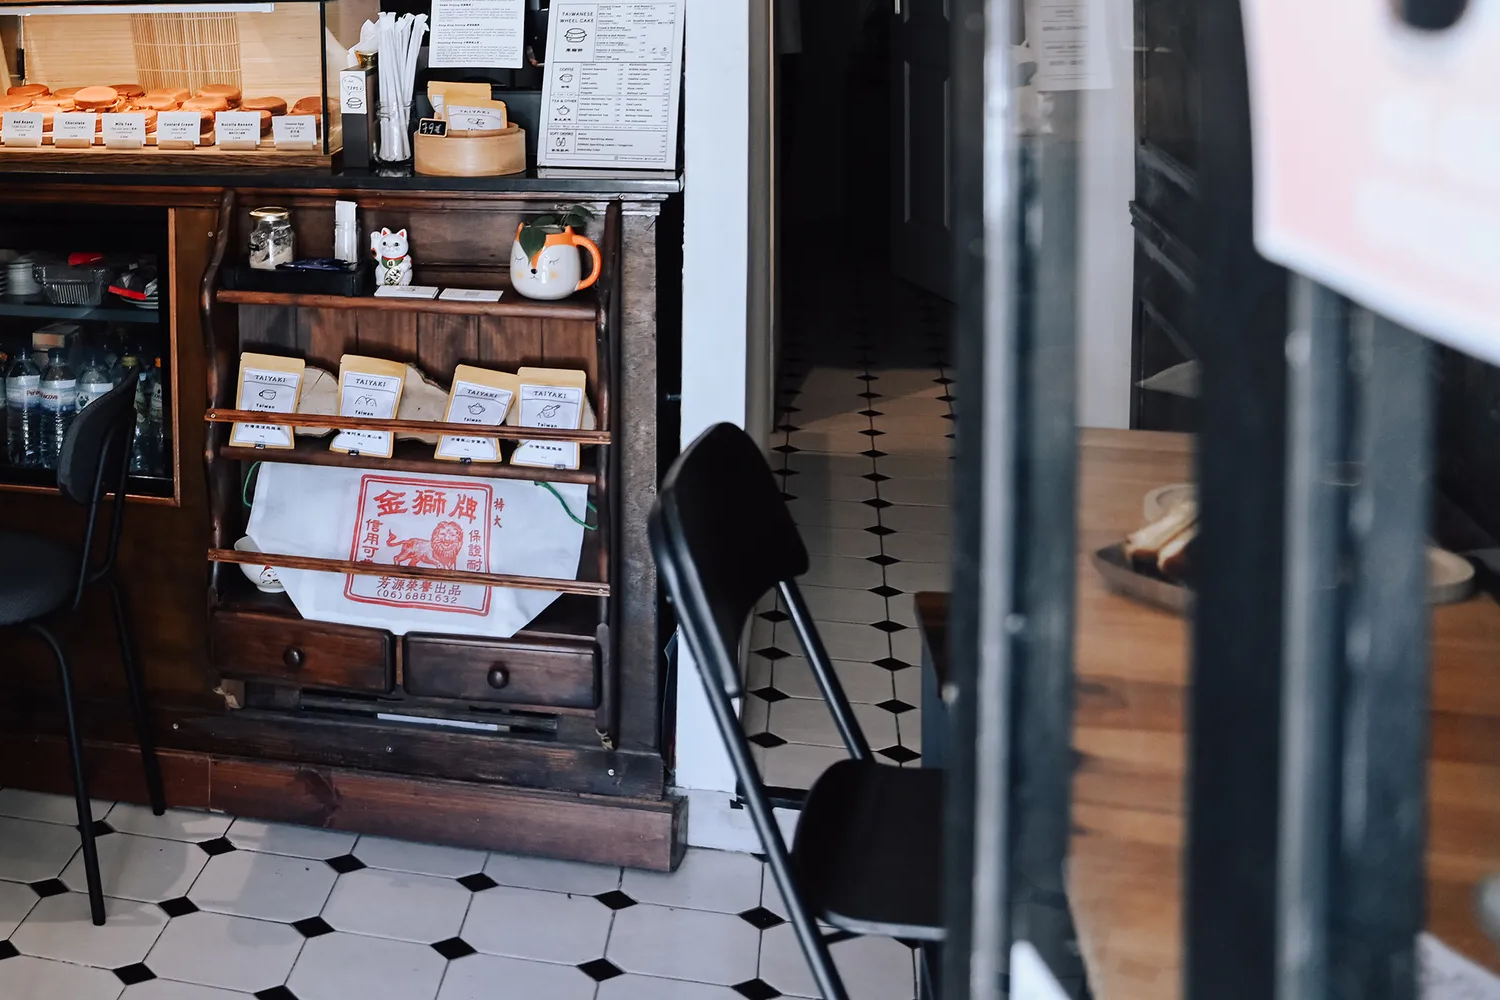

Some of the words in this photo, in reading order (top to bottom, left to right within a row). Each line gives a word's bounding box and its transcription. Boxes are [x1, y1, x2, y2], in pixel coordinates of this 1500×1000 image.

[255, 374, 287, 383] TAIYAKI
[355, 378, 387, 387] TAIYAKI
[467, 389, 498, 398] TAIYAKI
[534, 391, 567, 399] TAIYAKI
[373, 489, 479, 524] 金獅牌
[493, 498, 505, 528] 特大
[376, 589, 458, 604] (06)6881632
